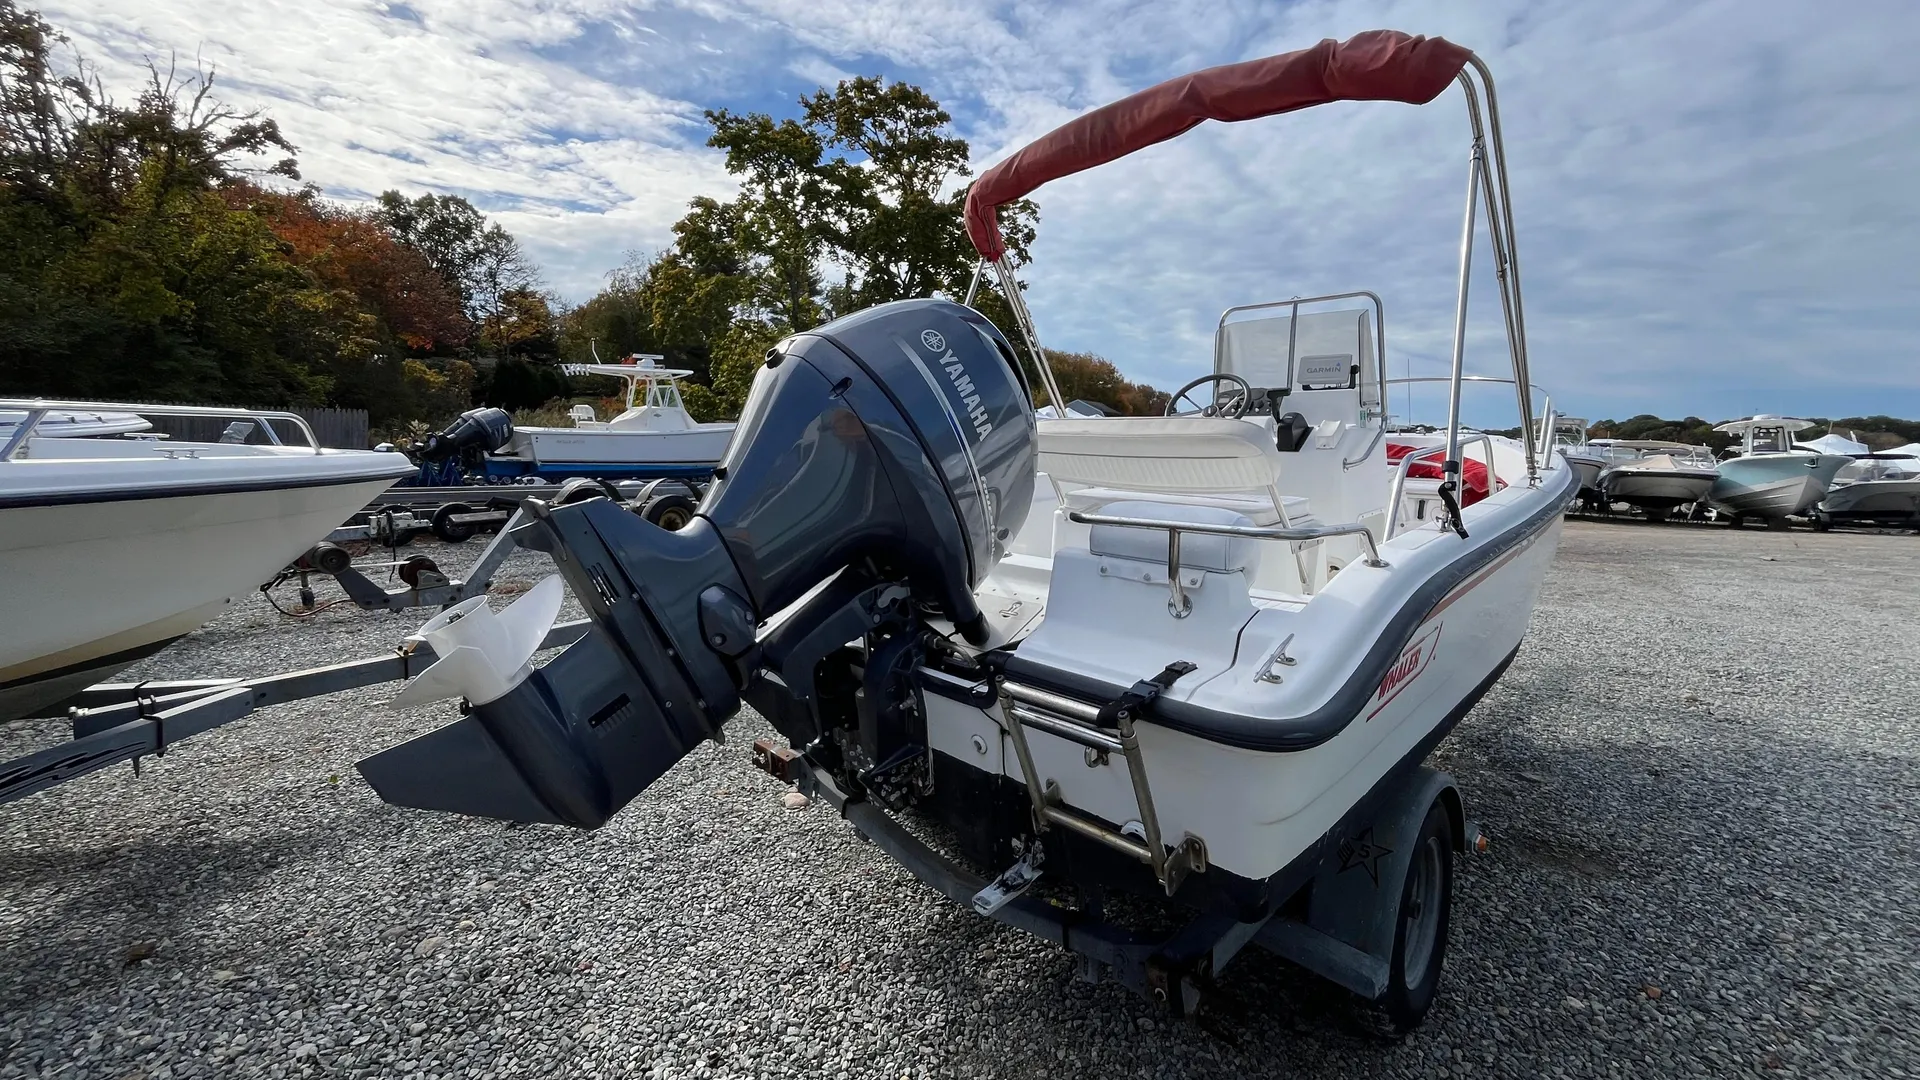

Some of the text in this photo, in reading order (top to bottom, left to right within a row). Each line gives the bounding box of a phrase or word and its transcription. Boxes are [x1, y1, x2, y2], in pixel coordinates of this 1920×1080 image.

[940, 349, 993, 442] YAMAHA
[1306, 366, 1341, 374] GARMIN
[1377, 647, 1422, 701] WHALER
